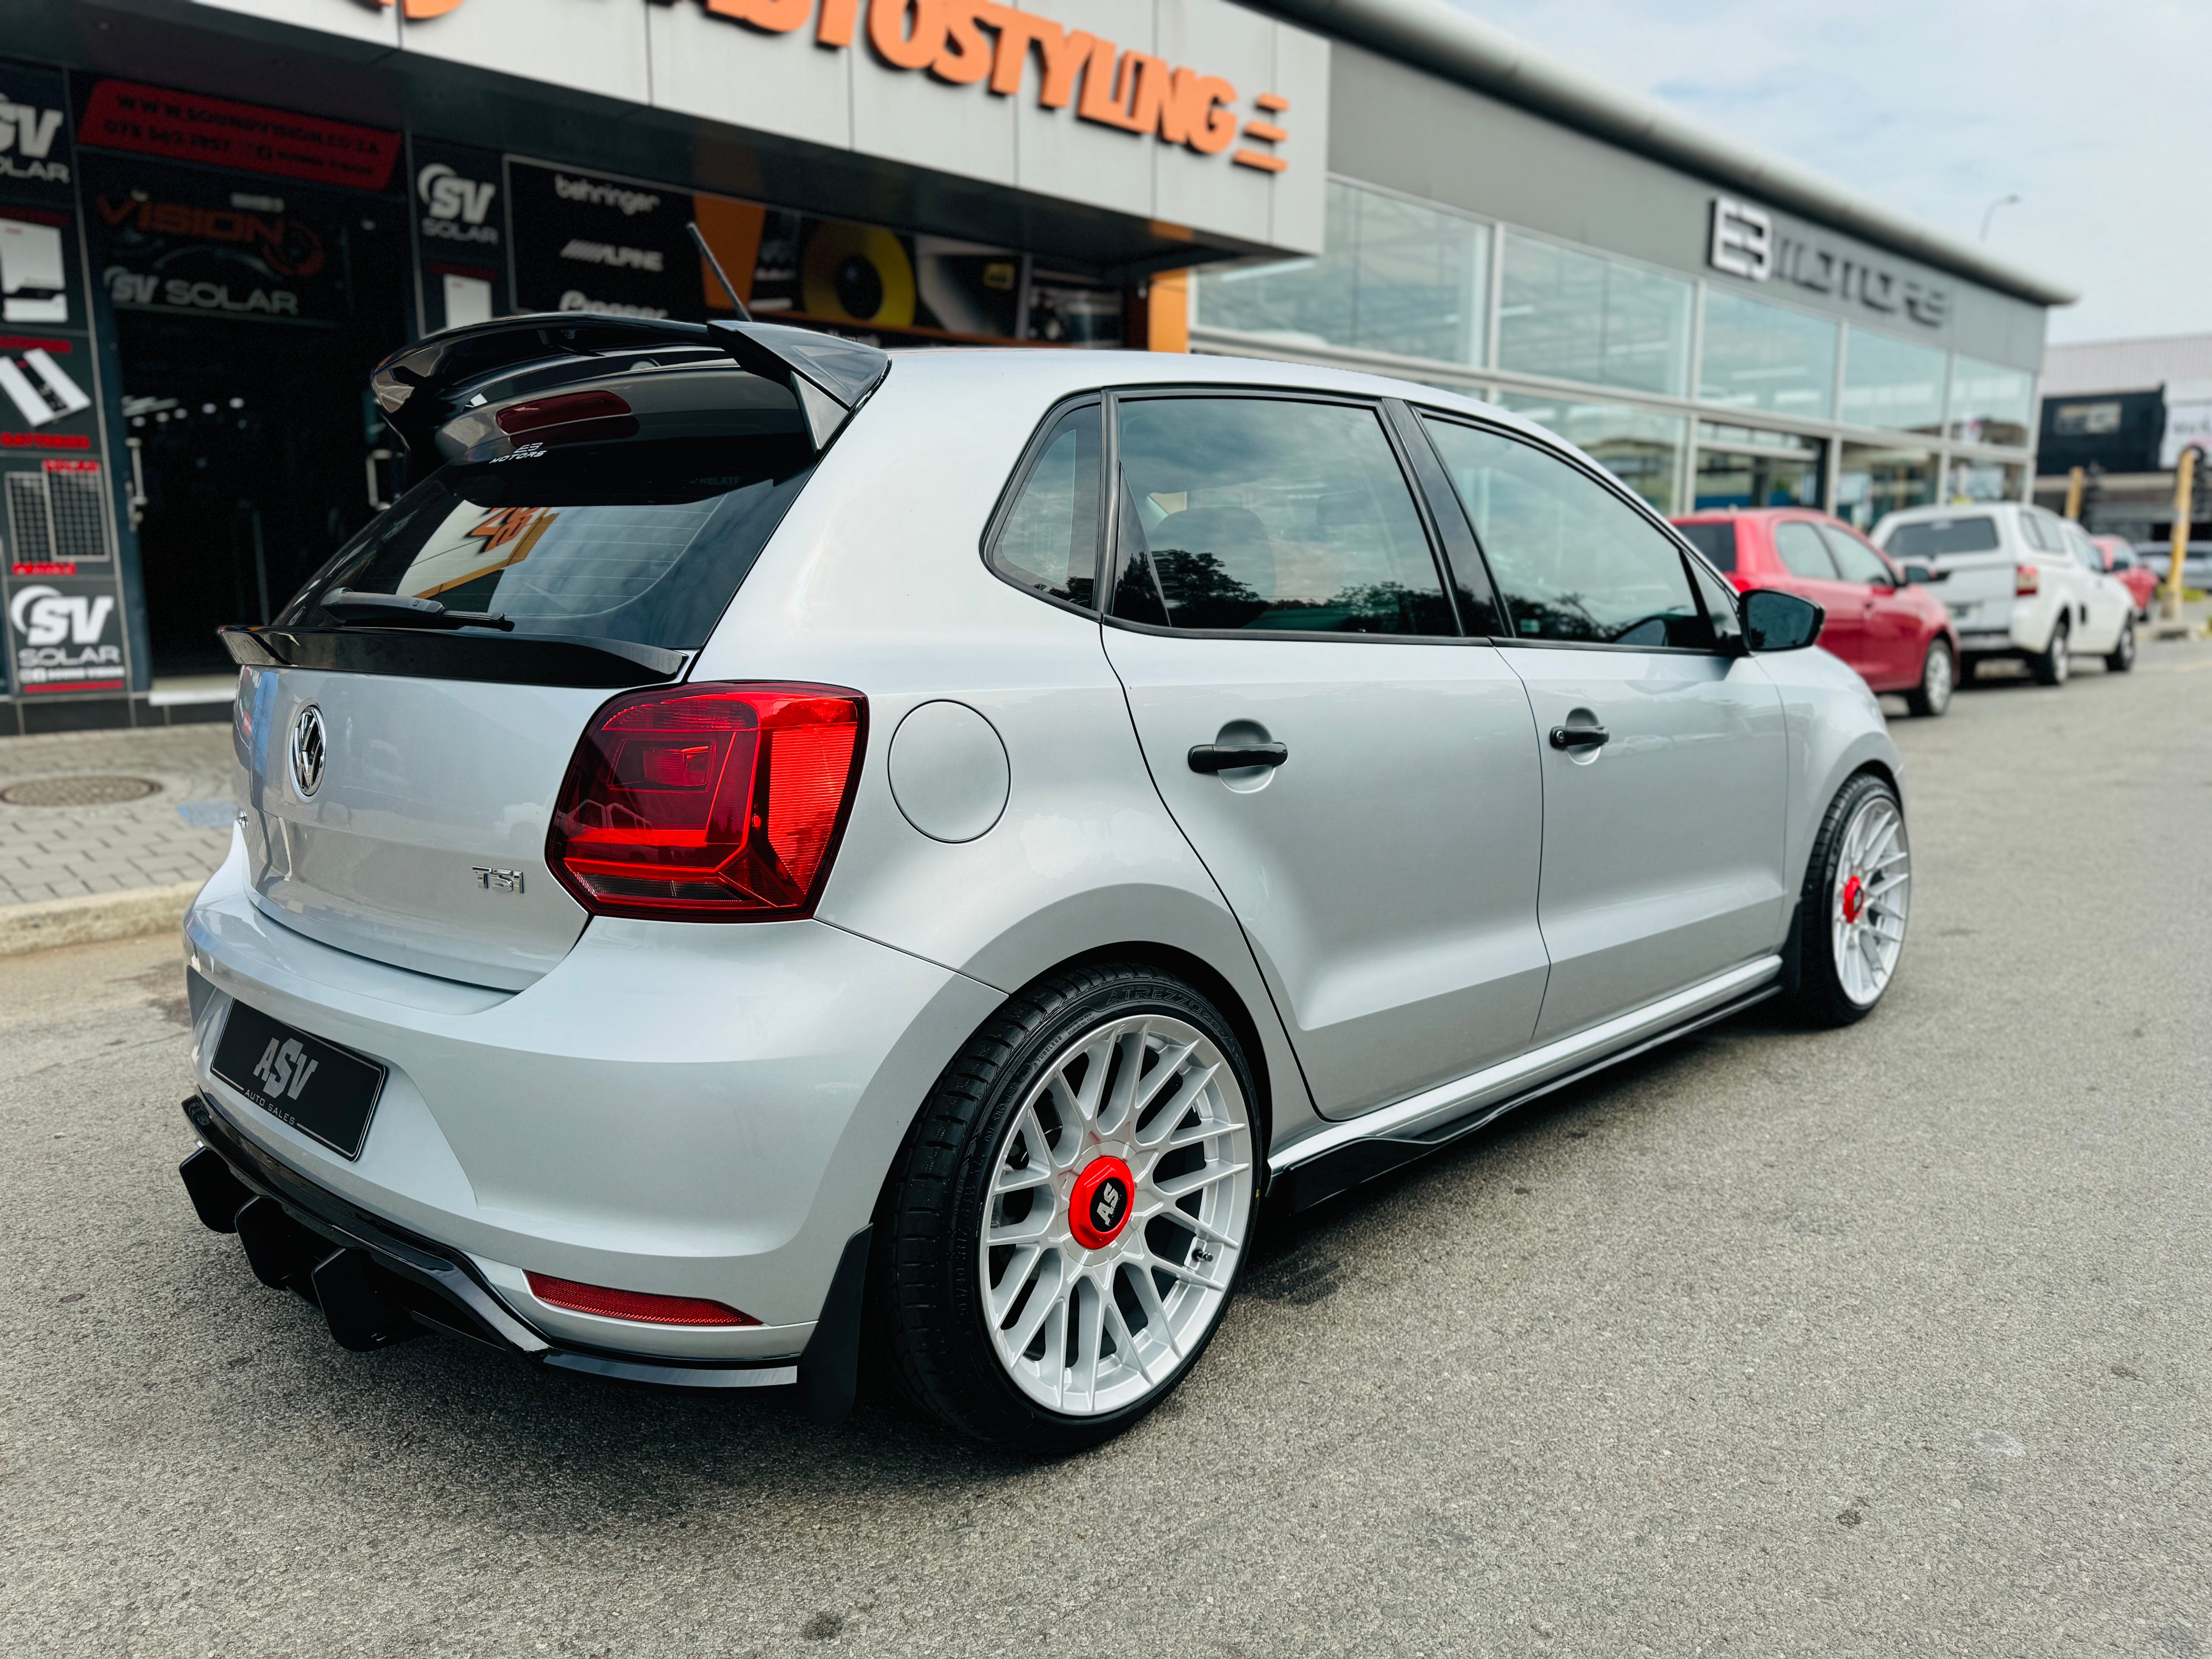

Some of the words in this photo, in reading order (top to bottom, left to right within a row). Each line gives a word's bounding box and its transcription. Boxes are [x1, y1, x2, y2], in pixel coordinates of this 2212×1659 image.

[165, 278, 299, 316] SOLAR
[489, 450, 548, 464] MOTORS
[27, 595, 114, 646] SV
[18, 644, 120, 668] SOLAR
[1107, 986, 1202, 1013] ATREZZO
[253, 1037, 319, 1100] ASV
[244, 1089, 265, 1106] AUTO
[267, 1103, 295, 1126] SALES
[1097, 1183, 1119, 1226] AS
